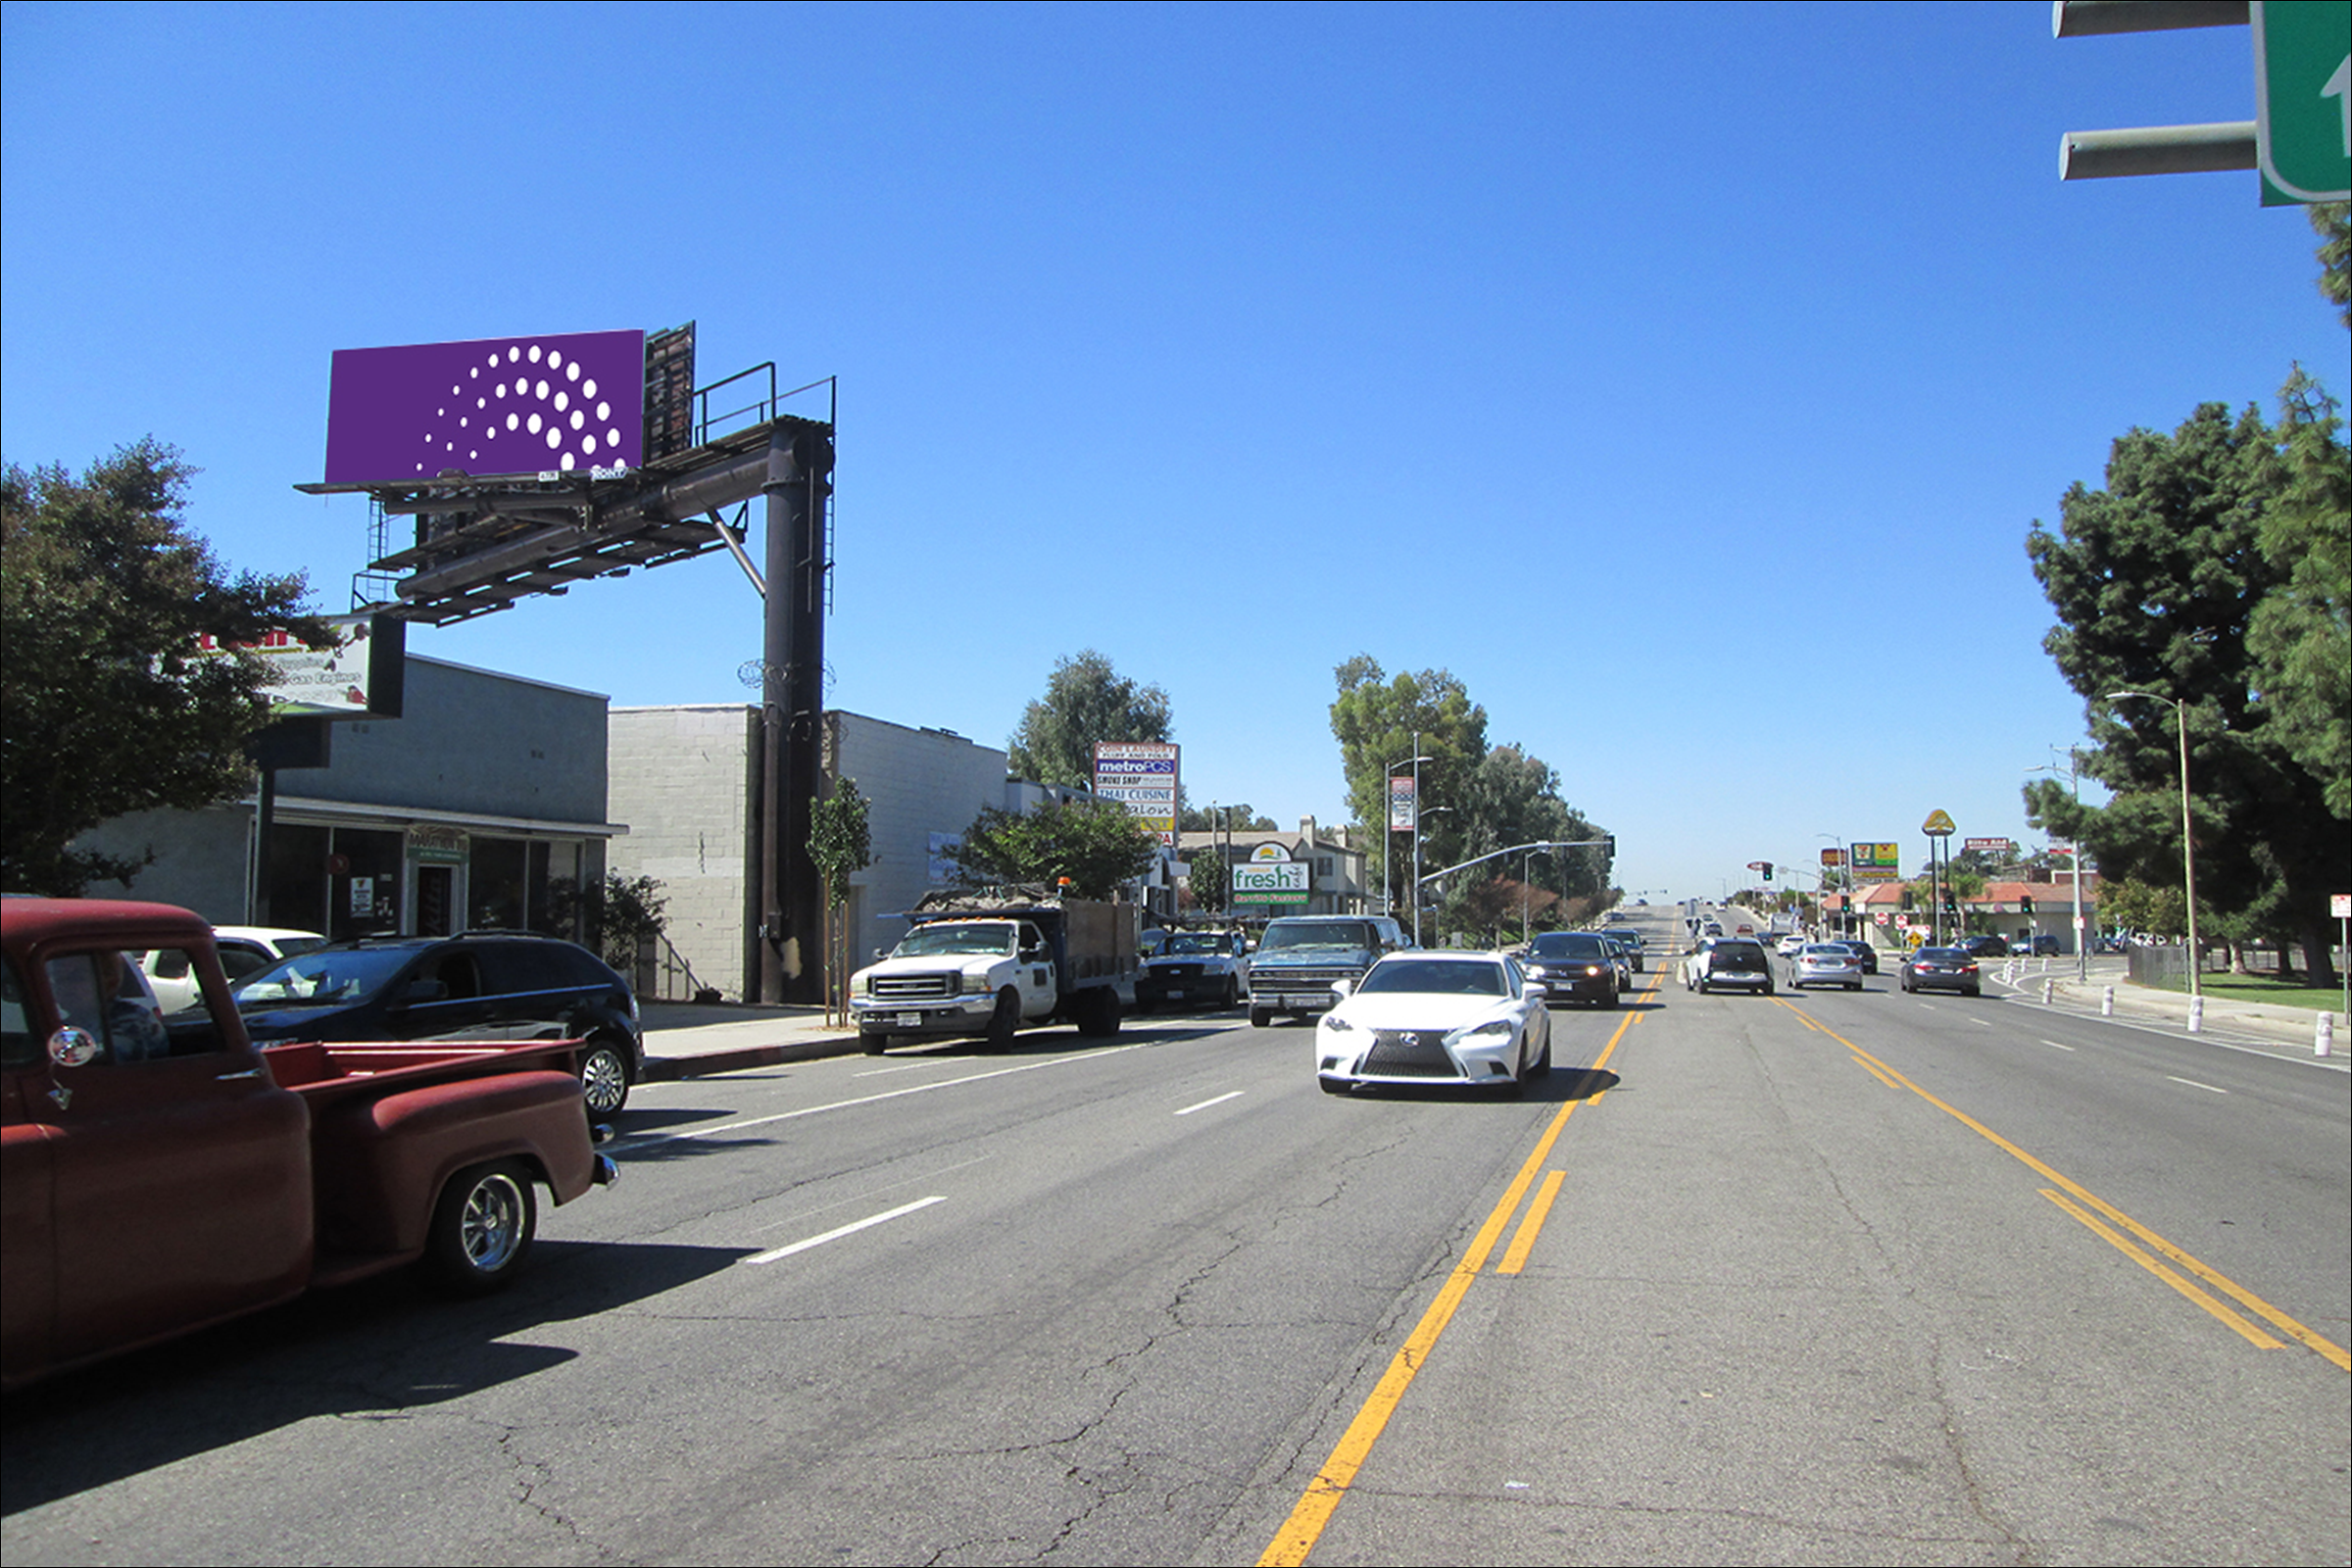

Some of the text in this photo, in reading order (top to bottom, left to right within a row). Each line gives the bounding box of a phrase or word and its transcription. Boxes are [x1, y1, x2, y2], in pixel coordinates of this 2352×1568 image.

[290, 670, 362, 686] Gas Engines
[1099, 760, 1172, 772] metroPCS
[1122, 776, 1141, 785] SHOP
[1099, 789, 1172, 801] THAI CUISINE
[1235, 864, 1291, 888] fresh
